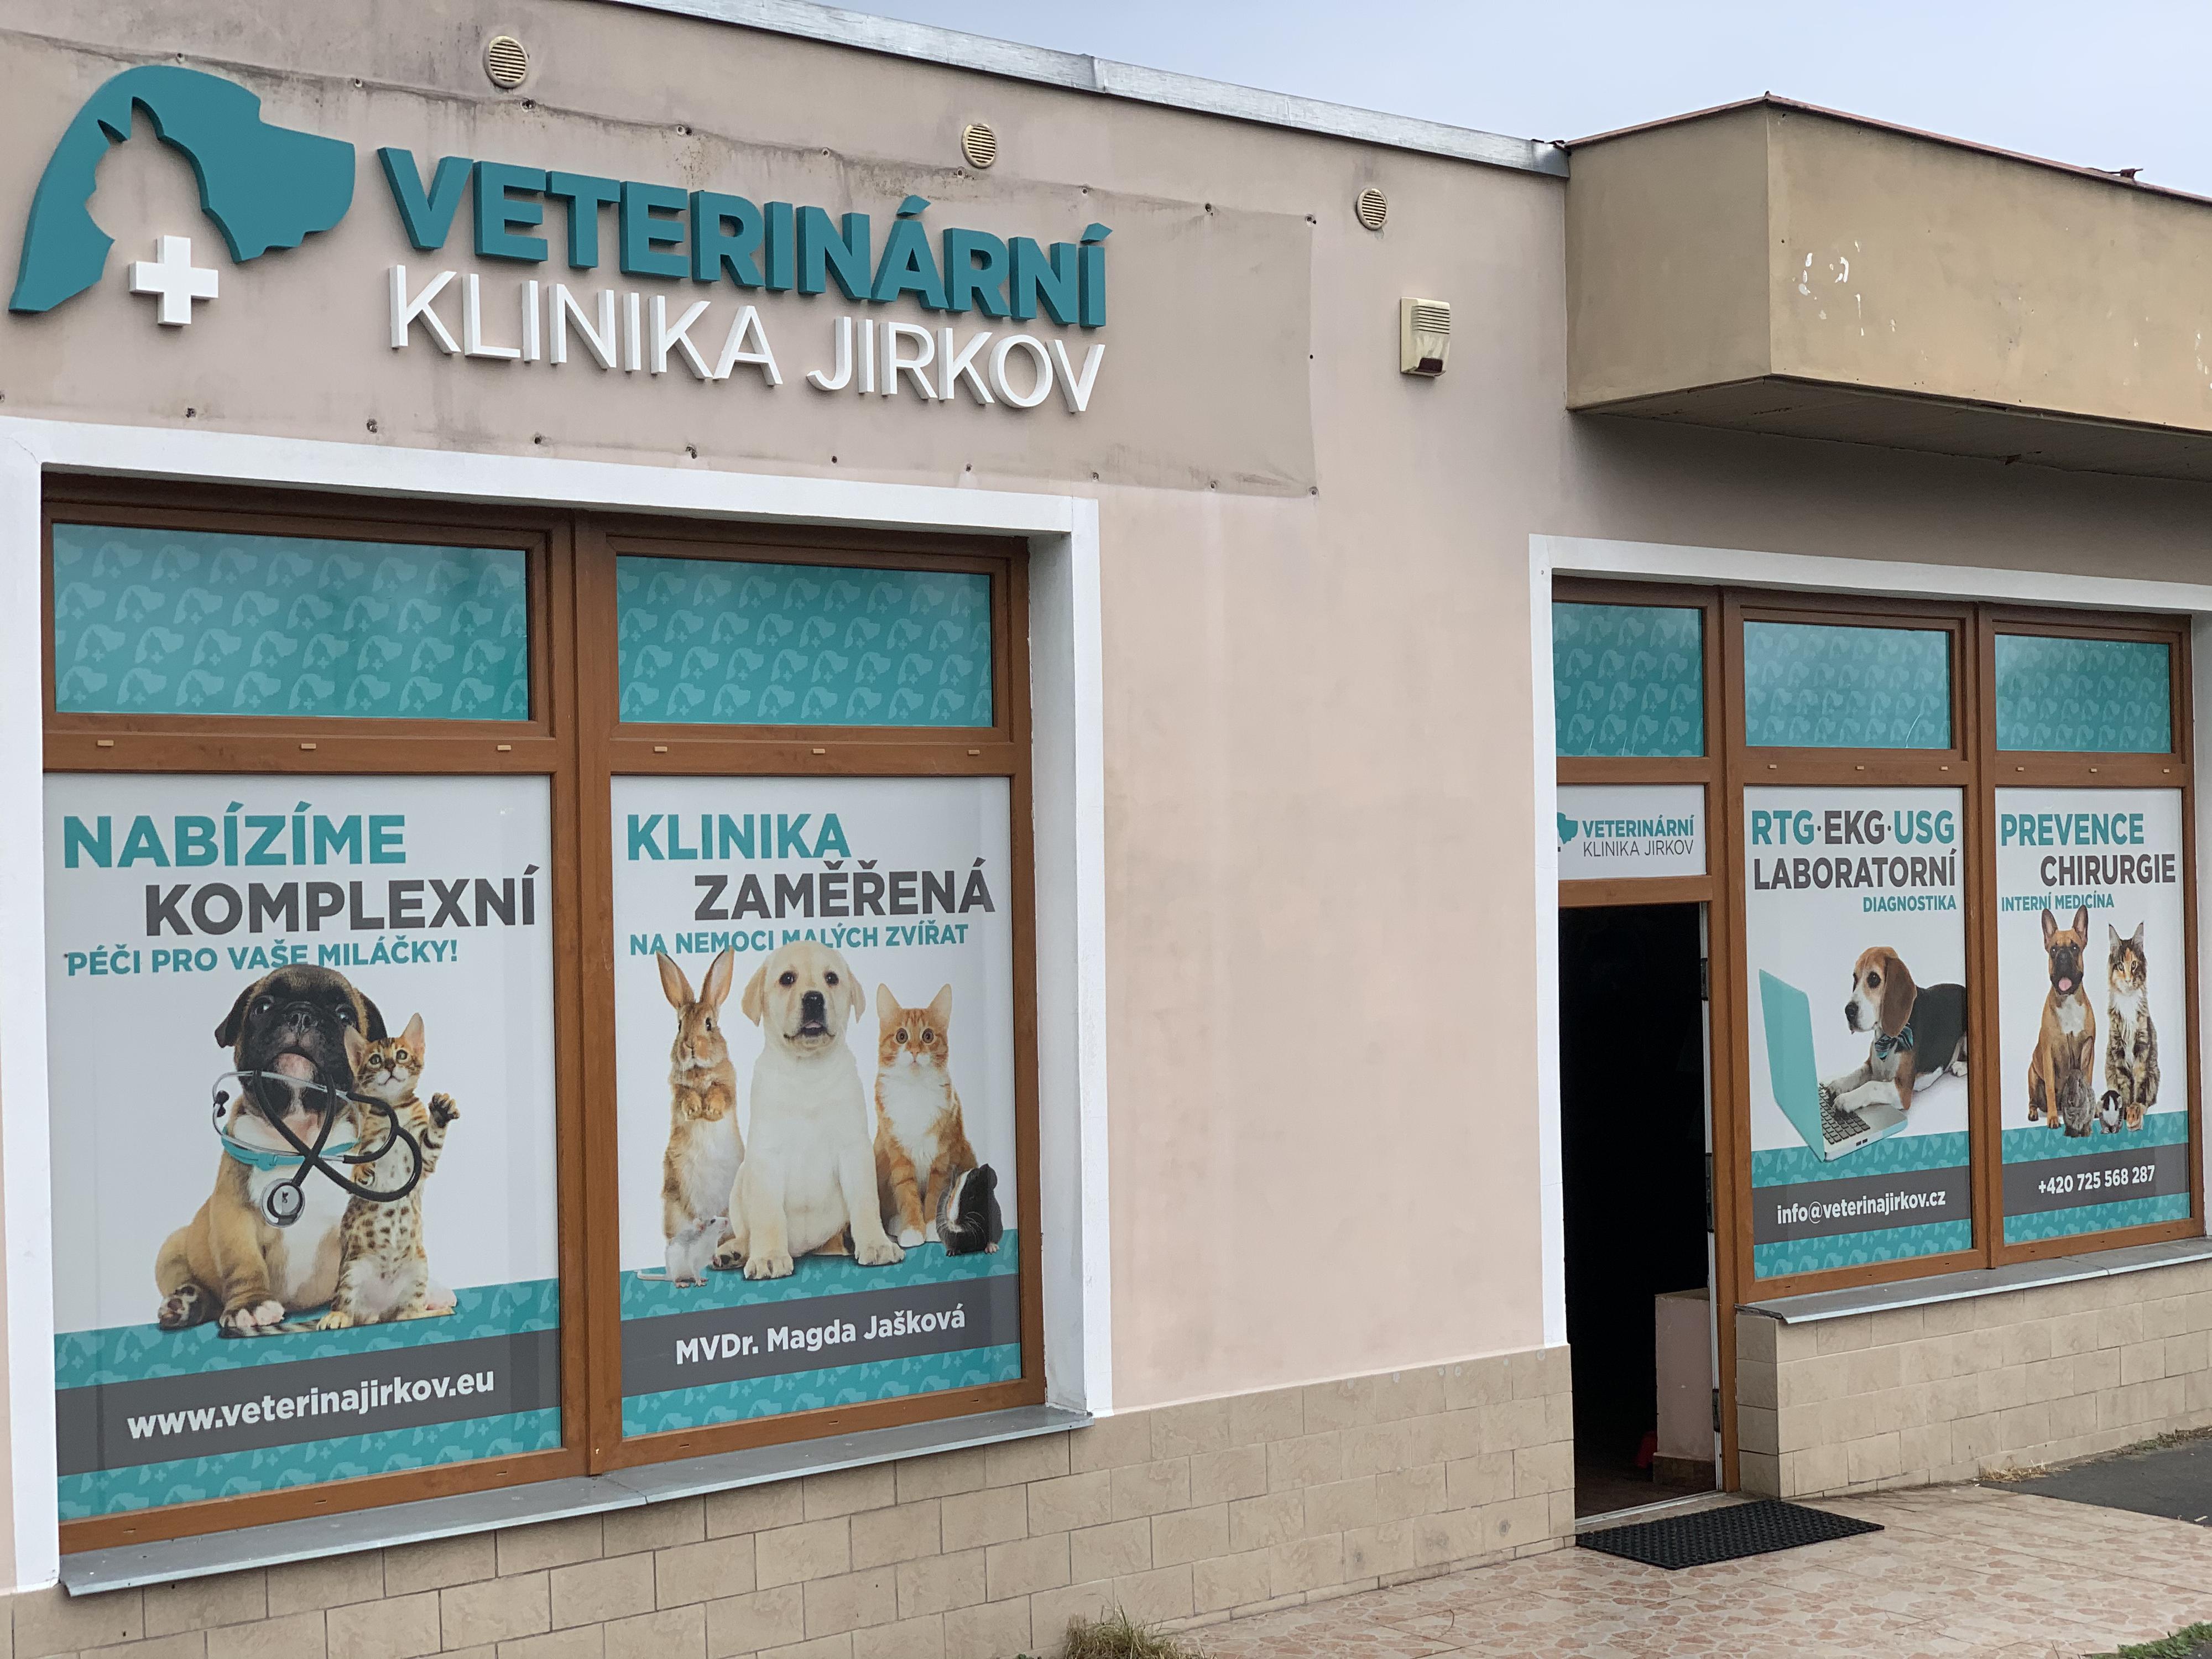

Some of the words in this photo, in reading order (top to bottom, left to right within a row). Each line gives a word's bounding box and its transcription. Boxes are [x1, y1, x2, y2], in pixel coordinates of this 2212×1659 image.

[377, 147, 1113, 328] VETERINÁRNÍ
[389, 263, 783, 386] KLINIKA
[805, 315, 1105, 413] JIRKOV
[64, 801, 406, 868] NABÍZÍME
[628, 813, 852, 860] KLINIKA
[1582, 814, 1694, 838] VETERINÁRNÍ
[2001, 813, 2145, 846] PREVENCE
[1583, 841, 1640, 857] KLINIKA
[1644, 839, 1694, 856] JIRKOV
[694, 857, 995, 921] ZAMĚŘENÁ
[1754, 848, 1958, 890] LABORATORNÍ
[2040, 853, 2176, 887] CHIRURGIE
[145, 864, 540, 936] KOMPLEXNÍ
[1863, 895, 1957, 913] DIAGNOSTIKA
[2001, 892, 2052, 912] INTERNÍ
[2055, 890, 2115, 910] MEDICÍNA
[68, 943, 140, 976] PÉČI
[152, 947, 218, 973] PRO
[227, 938, 309, 970] VAŠE
[319, 935, 458, 968] MILÁČKY!
[630, 933, 668, 956] NA
[676, 930, 774, 954] NEMOCI
[782, 922, 878, 948] MALÝCH
[886, 920, 969, 947] ZVÍŘAT
[2038, 1175, 2074, 1194] +420
[2077, 1171, 2101, 1191] 725
[2104, 1168, 2128, 1187] 568
[2132, 1165, 2155, 1184] 287
[1777, 1190, 1946, 1225] info@veterinajirkov.cz
[675, 1333, 759, 1365] MVDr.
[767, 1319, 857, 1353] Magda
[863, 1303, 966, 1340] Jašková
[127, 1369, 495, 1439] www.veterinajirkov.eu
